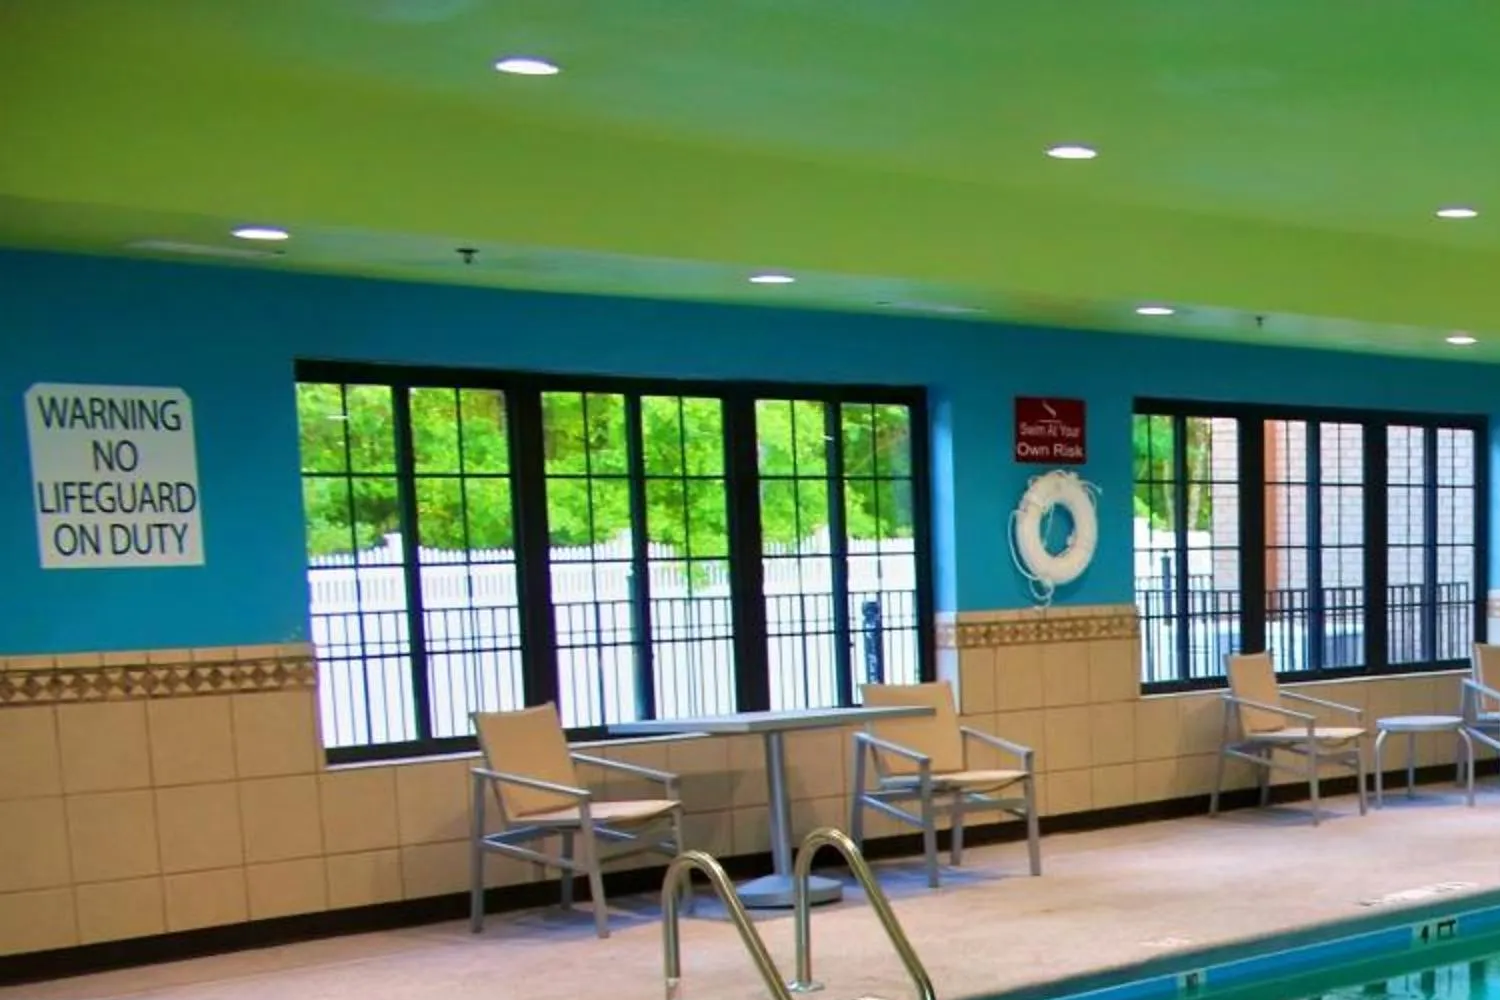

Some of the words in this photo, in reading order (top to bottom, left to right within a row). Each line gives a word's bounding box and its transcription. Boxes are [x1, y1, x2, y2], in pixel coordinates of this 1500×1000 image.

[37, 396, 182, 431] WARNING
[93, 440, 139, 472] NO
[1017, 441, 1051, 457] Own
[1053, 443, 1083, 458] Risk
[38, 481, 197, 513] LIFEGUARD
[54, 523, 102, 556] ON
[110, 523, 188, 555] DUTY
